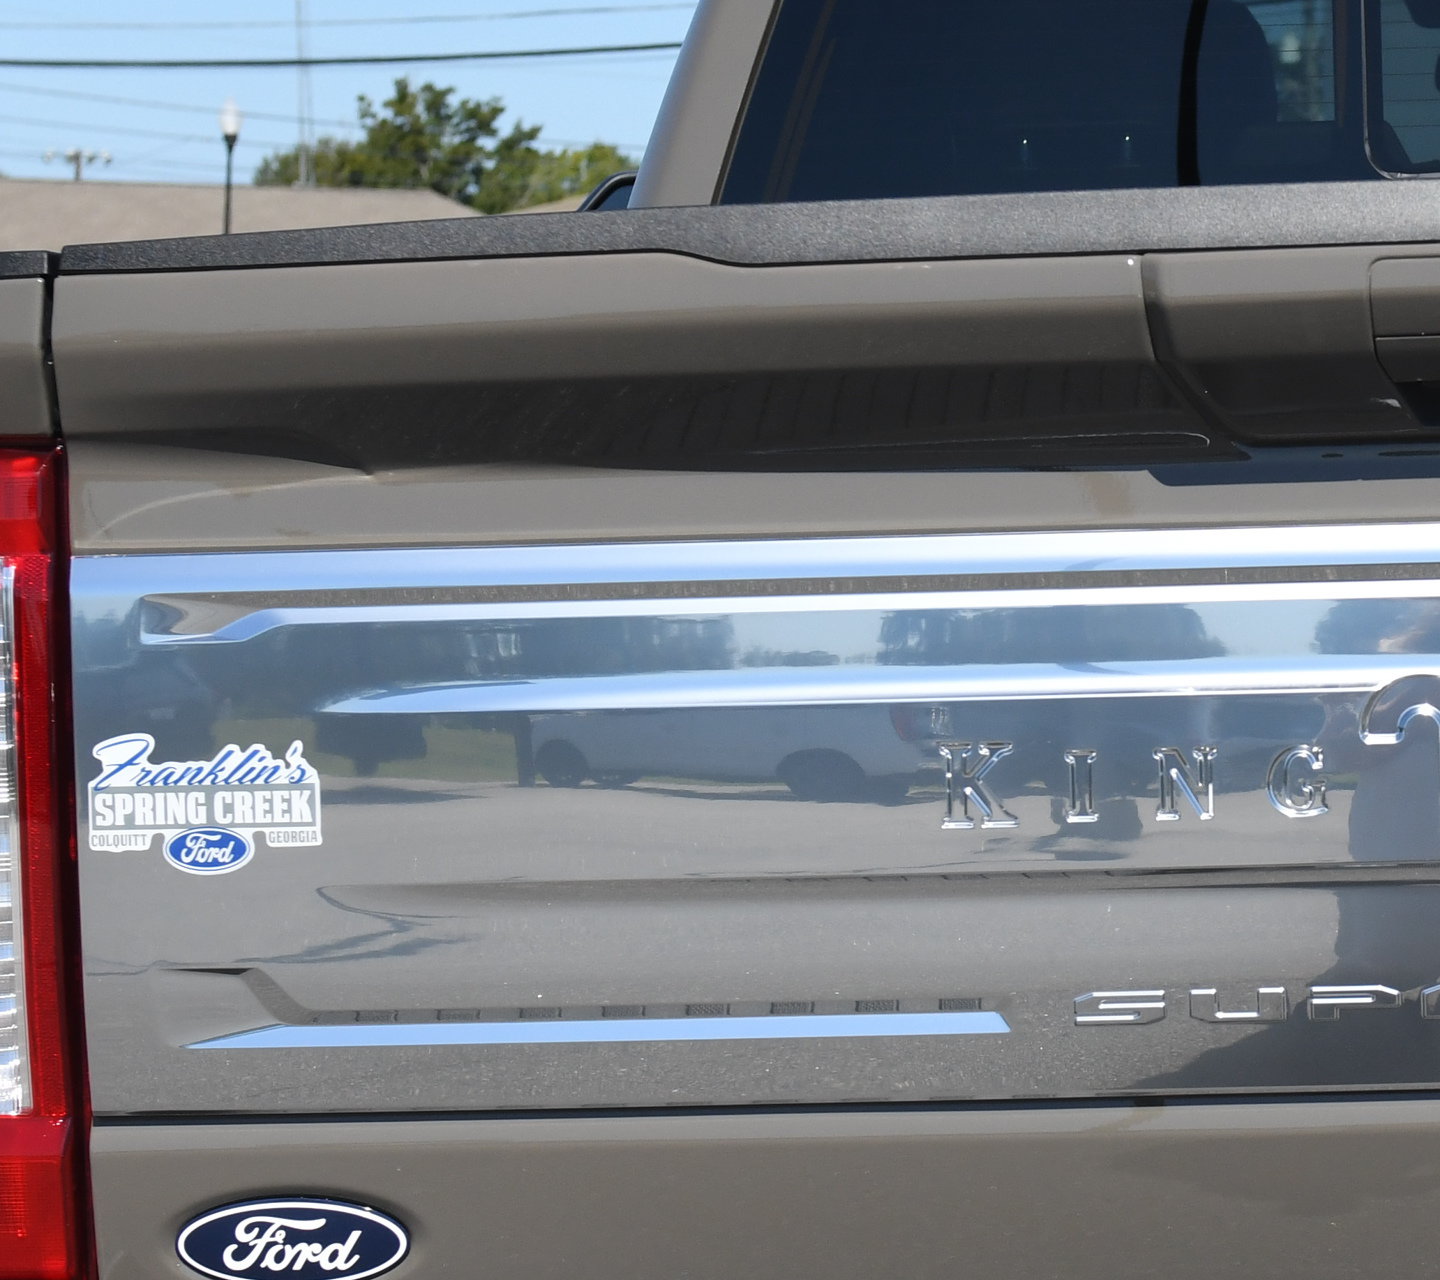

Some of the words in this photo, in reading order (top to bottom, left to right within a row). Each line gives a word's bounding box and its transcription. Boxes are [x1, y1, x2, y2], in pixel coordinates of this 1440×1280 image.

[93, 738, 312, 791] Franklin's
[936, 739, 1329, 830] KING
[95, 793, 207, 827] SPRING
[214, 789, 313, 825] CREEK
[91, 834, 147, 848] COLQUITT
[268, 830, 318, 844] GEORGIA
[180, 833, 234, 864] Ford
[222, 1215, 362, 1271] Ford
